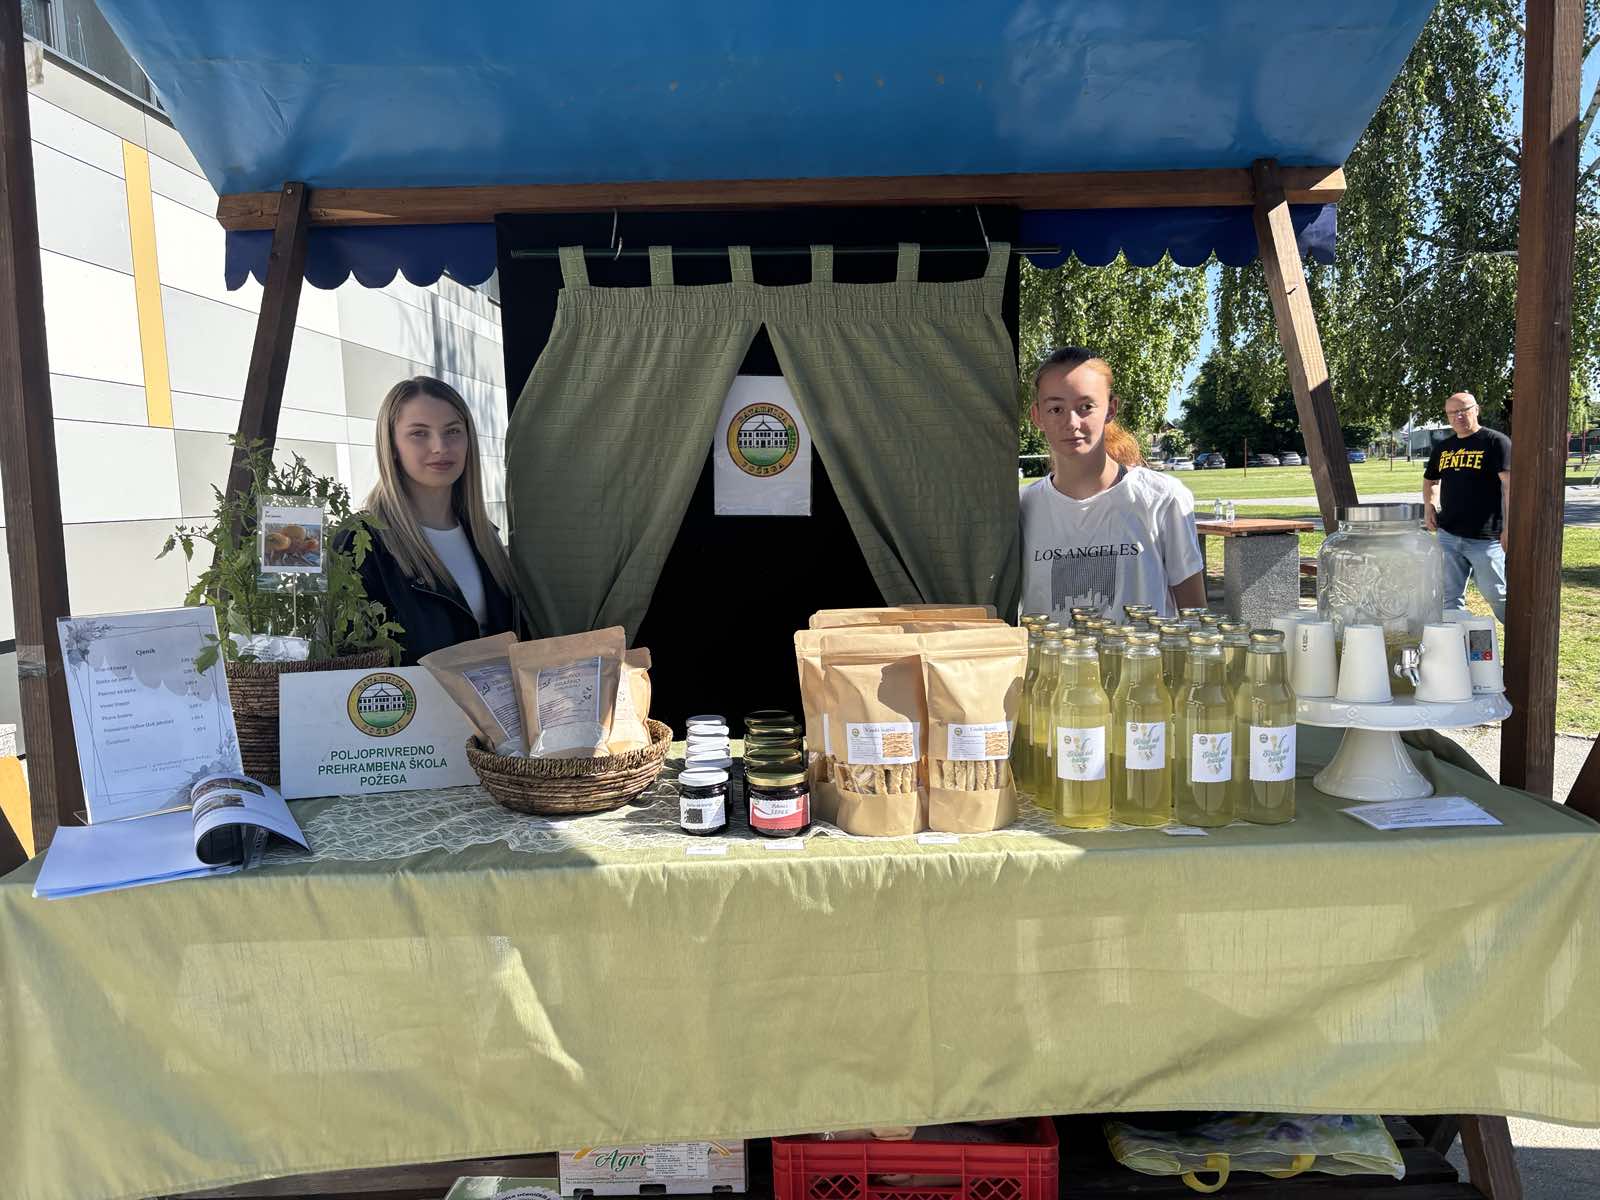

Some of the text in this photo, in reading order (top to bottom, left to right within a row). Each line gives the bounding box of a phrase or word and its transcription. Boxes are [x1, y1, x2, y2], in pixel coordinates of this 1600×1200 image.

[1034, 544, 1140, 561] LOS ANGELES
[330, 744, 435, 761] POLJOPRIVREDNO
[318, 758, 448, 776] PREHRAMBENA ŠKOLA
[360, 774, 407, 787] POŽEGA
